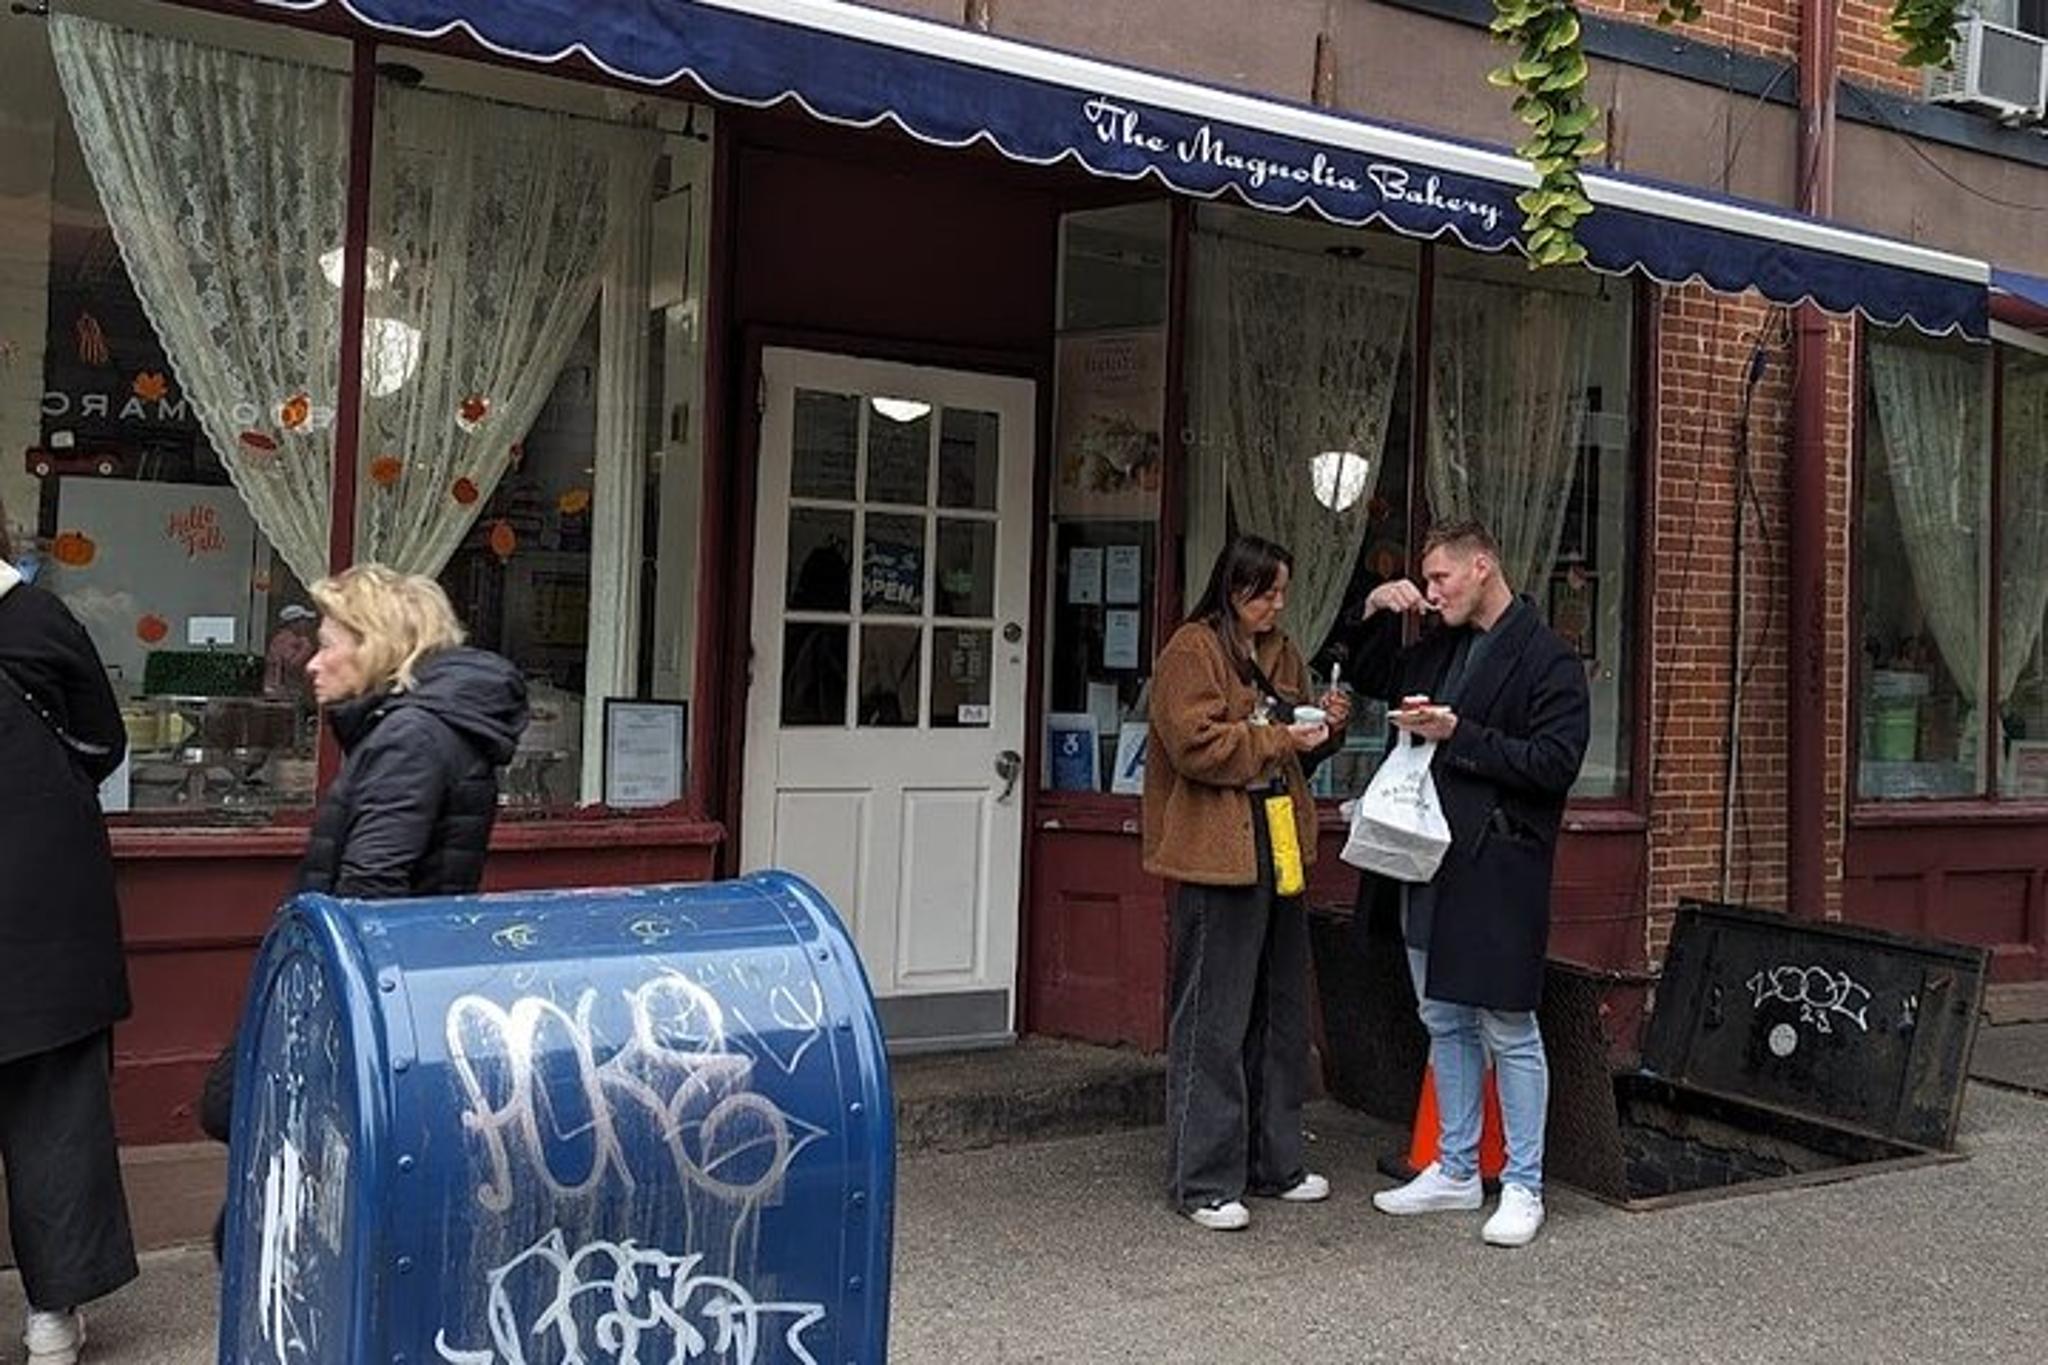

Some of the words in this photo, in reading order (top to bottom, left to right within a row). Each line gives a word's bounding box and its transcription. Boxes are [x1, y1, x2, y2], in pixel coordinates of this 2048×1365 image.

[1084, 97, 1169, 151] The
[1178, 124, 1362, 188] Magnolia
[1367, 163, 1503, 231] Bakery
